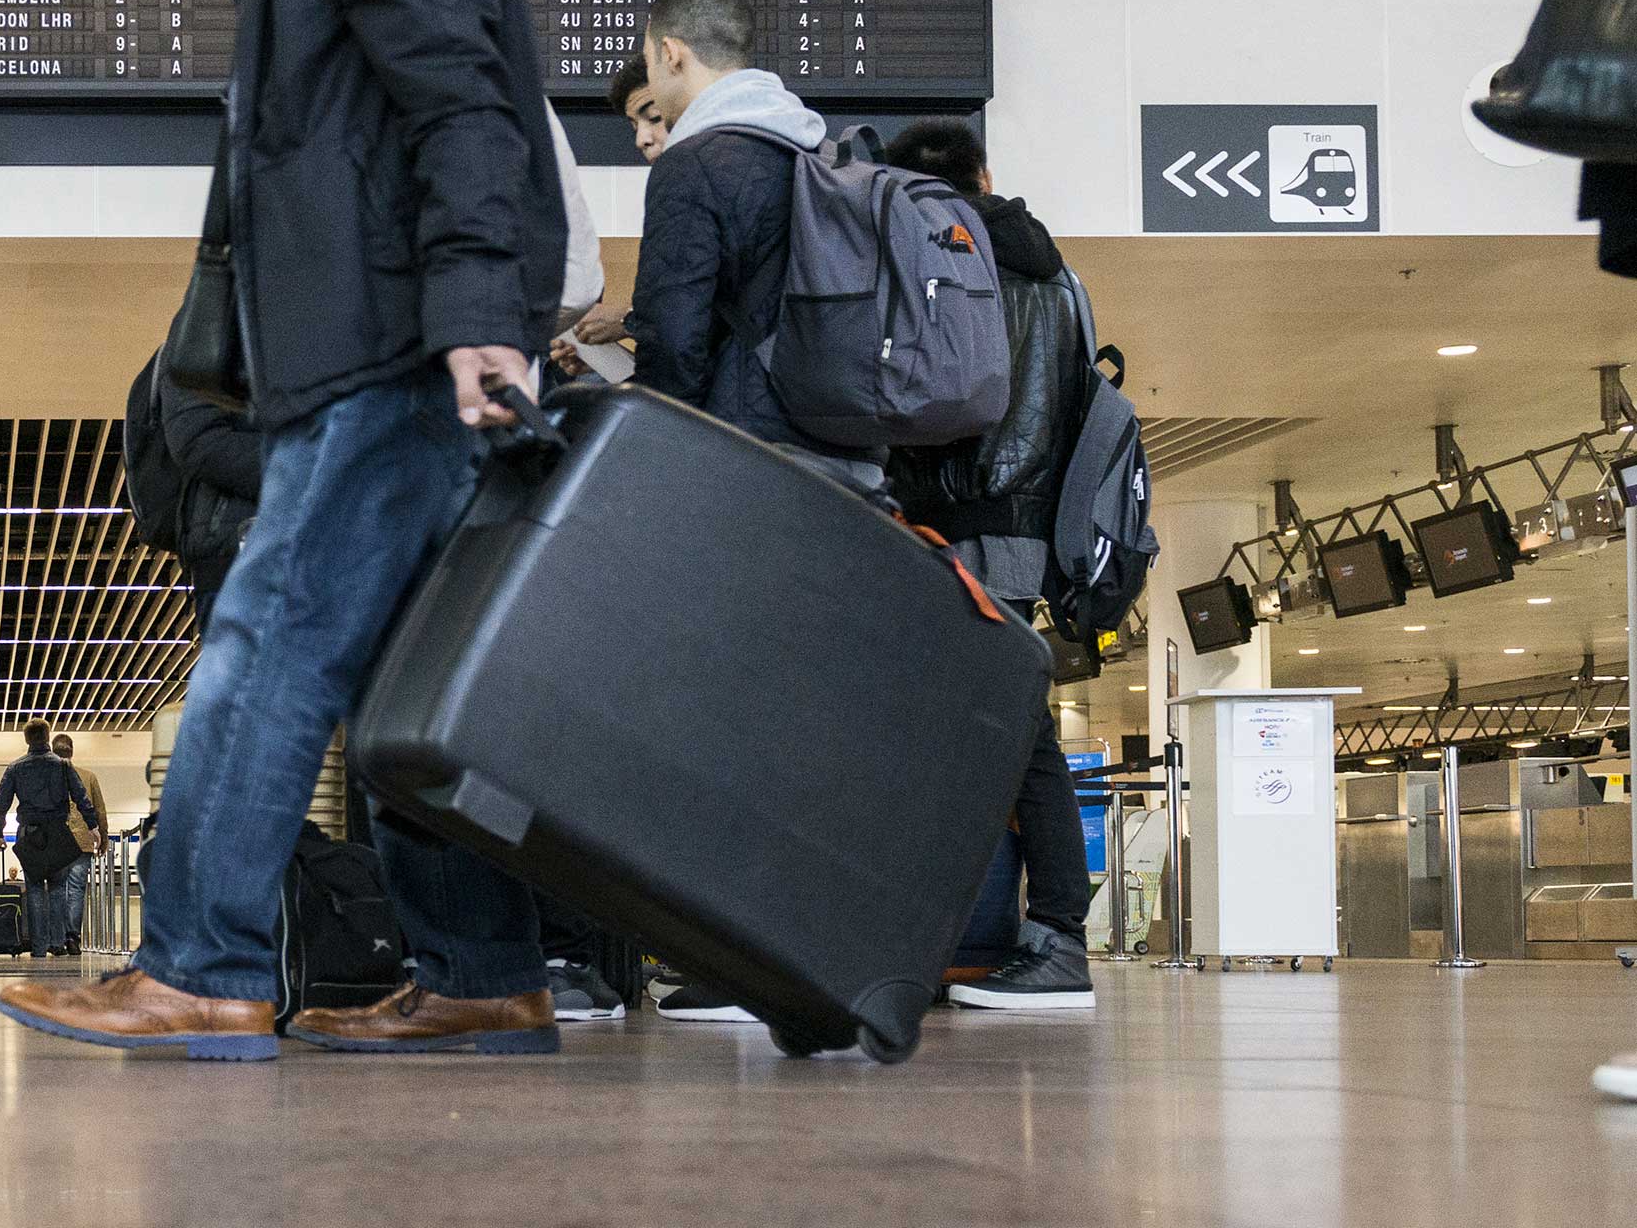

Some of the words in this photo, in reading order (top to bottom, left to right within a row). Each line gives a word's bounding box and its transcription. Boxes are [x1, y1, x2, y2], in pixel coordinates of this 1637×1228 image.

[41, 12, 72, 28] LHR
[560, 12, 581, 27] 4U
[593, 12, 635, 27] 2163
[1302, 131, 1333, 144] Train
